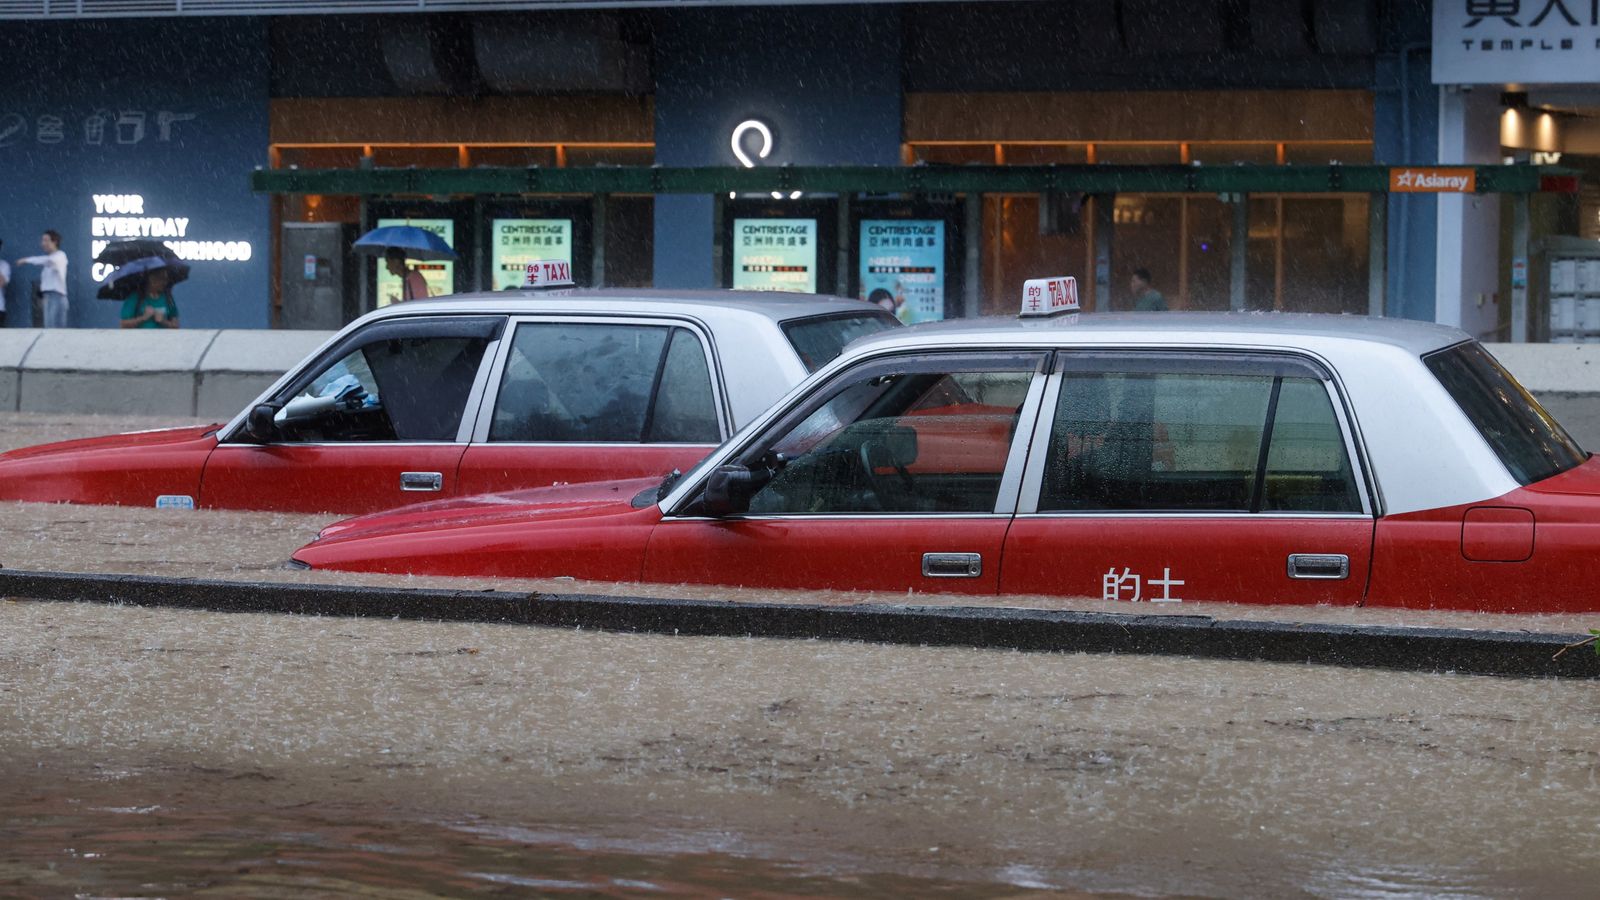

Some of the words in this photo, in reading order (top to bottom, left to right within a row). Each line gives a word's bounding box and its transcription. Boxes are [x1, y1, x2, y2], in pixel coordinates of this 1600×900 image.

[1462, 39, 1573, 51] TEMPLE
[1415, 172, 1468, 191] Asiaray
[93, 194, 144, 214] YOUR
[92, 217, 189, 237] EVERYDAY
[501, 225, 563, 234] CENTRESTAGE
[742, 225, 808, 234] CENTRESTAGE
[868, 226, 936, 235] CENTRESTAGE
[527, 264, 539, 284] 的士
[543, 262, 570, 281] TAXI
[1028, 286, 1041, 308] 的士
[1048, 279, 1076, 307] TAXI
[1103, 567, 1185, 602] 的士
